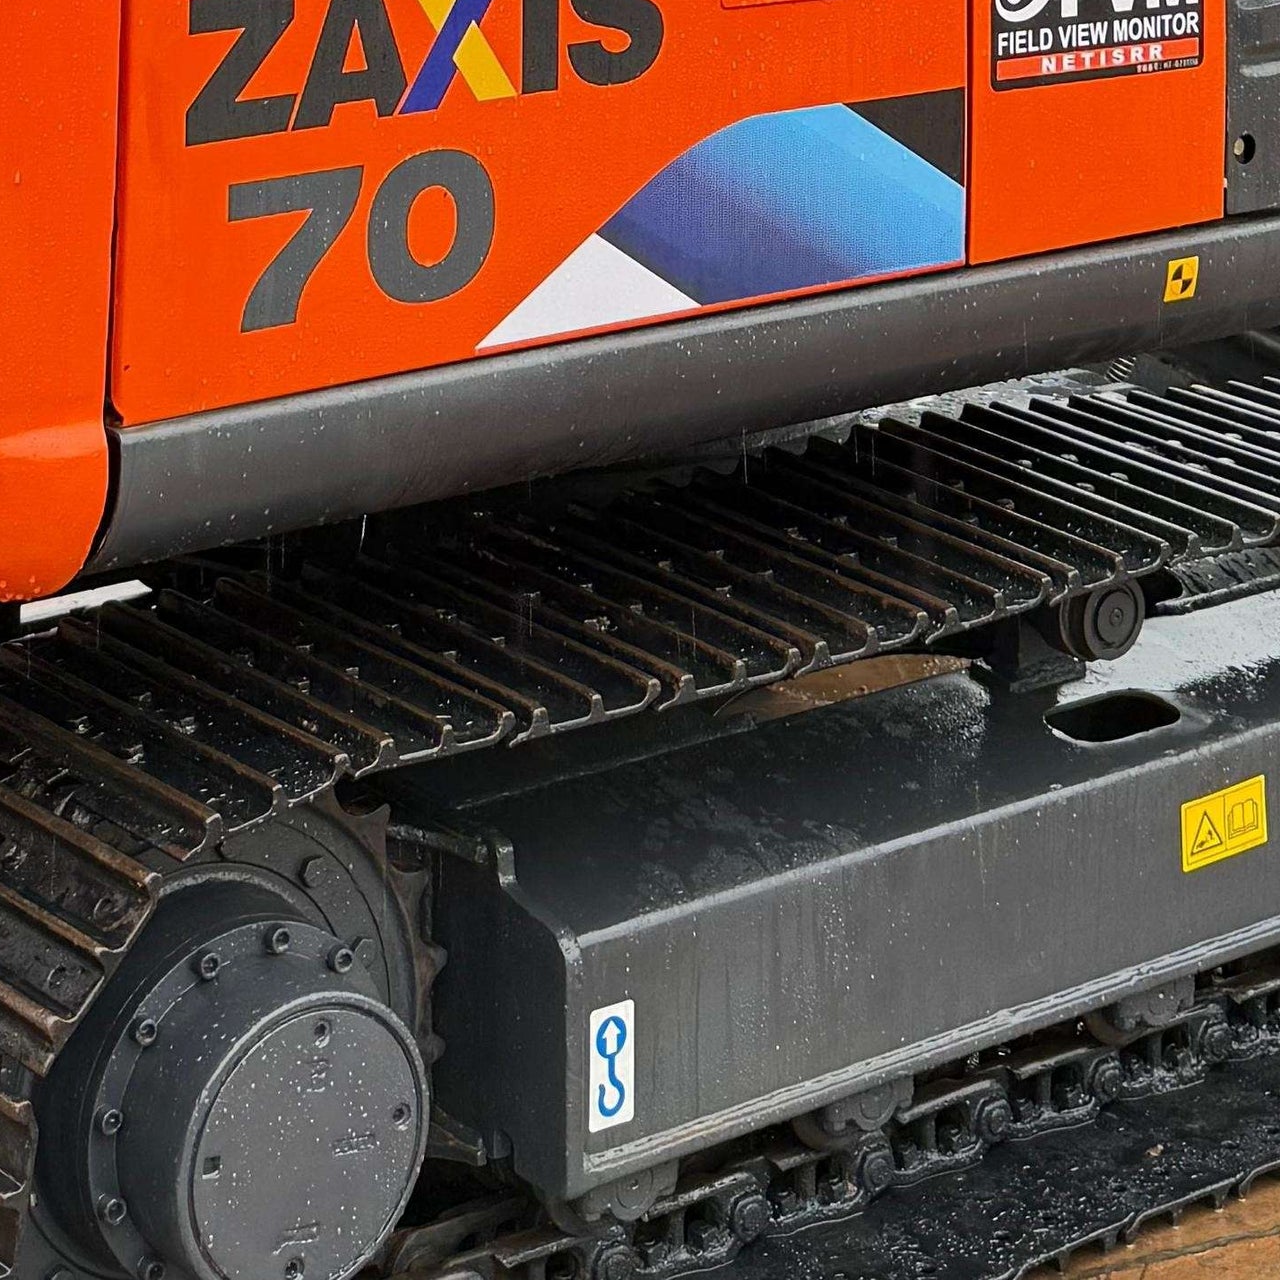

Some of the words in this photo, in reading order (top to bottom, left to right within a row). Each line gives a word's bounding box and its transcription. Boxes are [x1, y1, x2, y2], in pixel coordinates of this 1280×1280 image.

[997, 27, 1053, 56] FIELD
[1058, 21, 1108, 47] VIEW
[1113, 11, 1200, 42] MONITOR
[228, 149, 495, 333] 70
